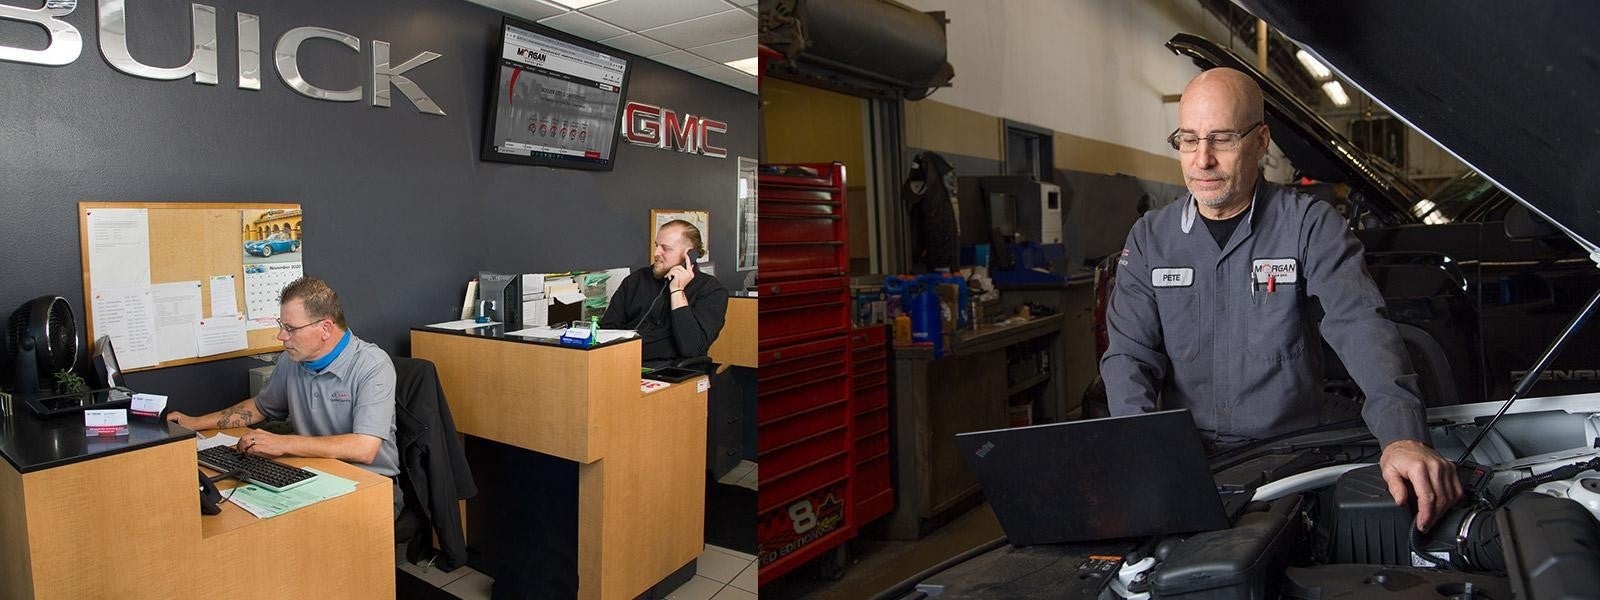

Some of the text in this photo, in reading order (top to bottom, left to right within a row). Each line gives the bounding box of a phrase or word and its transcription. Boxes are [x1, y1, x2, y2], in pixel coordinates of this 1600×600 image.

[0, 0, 447, 116] BUICK
[516, 47, 547, 62] MORGAN
[622, 101, 728, 158] GMC
[1162, 273, 1181, 282] PETE
[1254, 263, 1296, 273] MORGAN
[788, 500, 816, 534] 8
